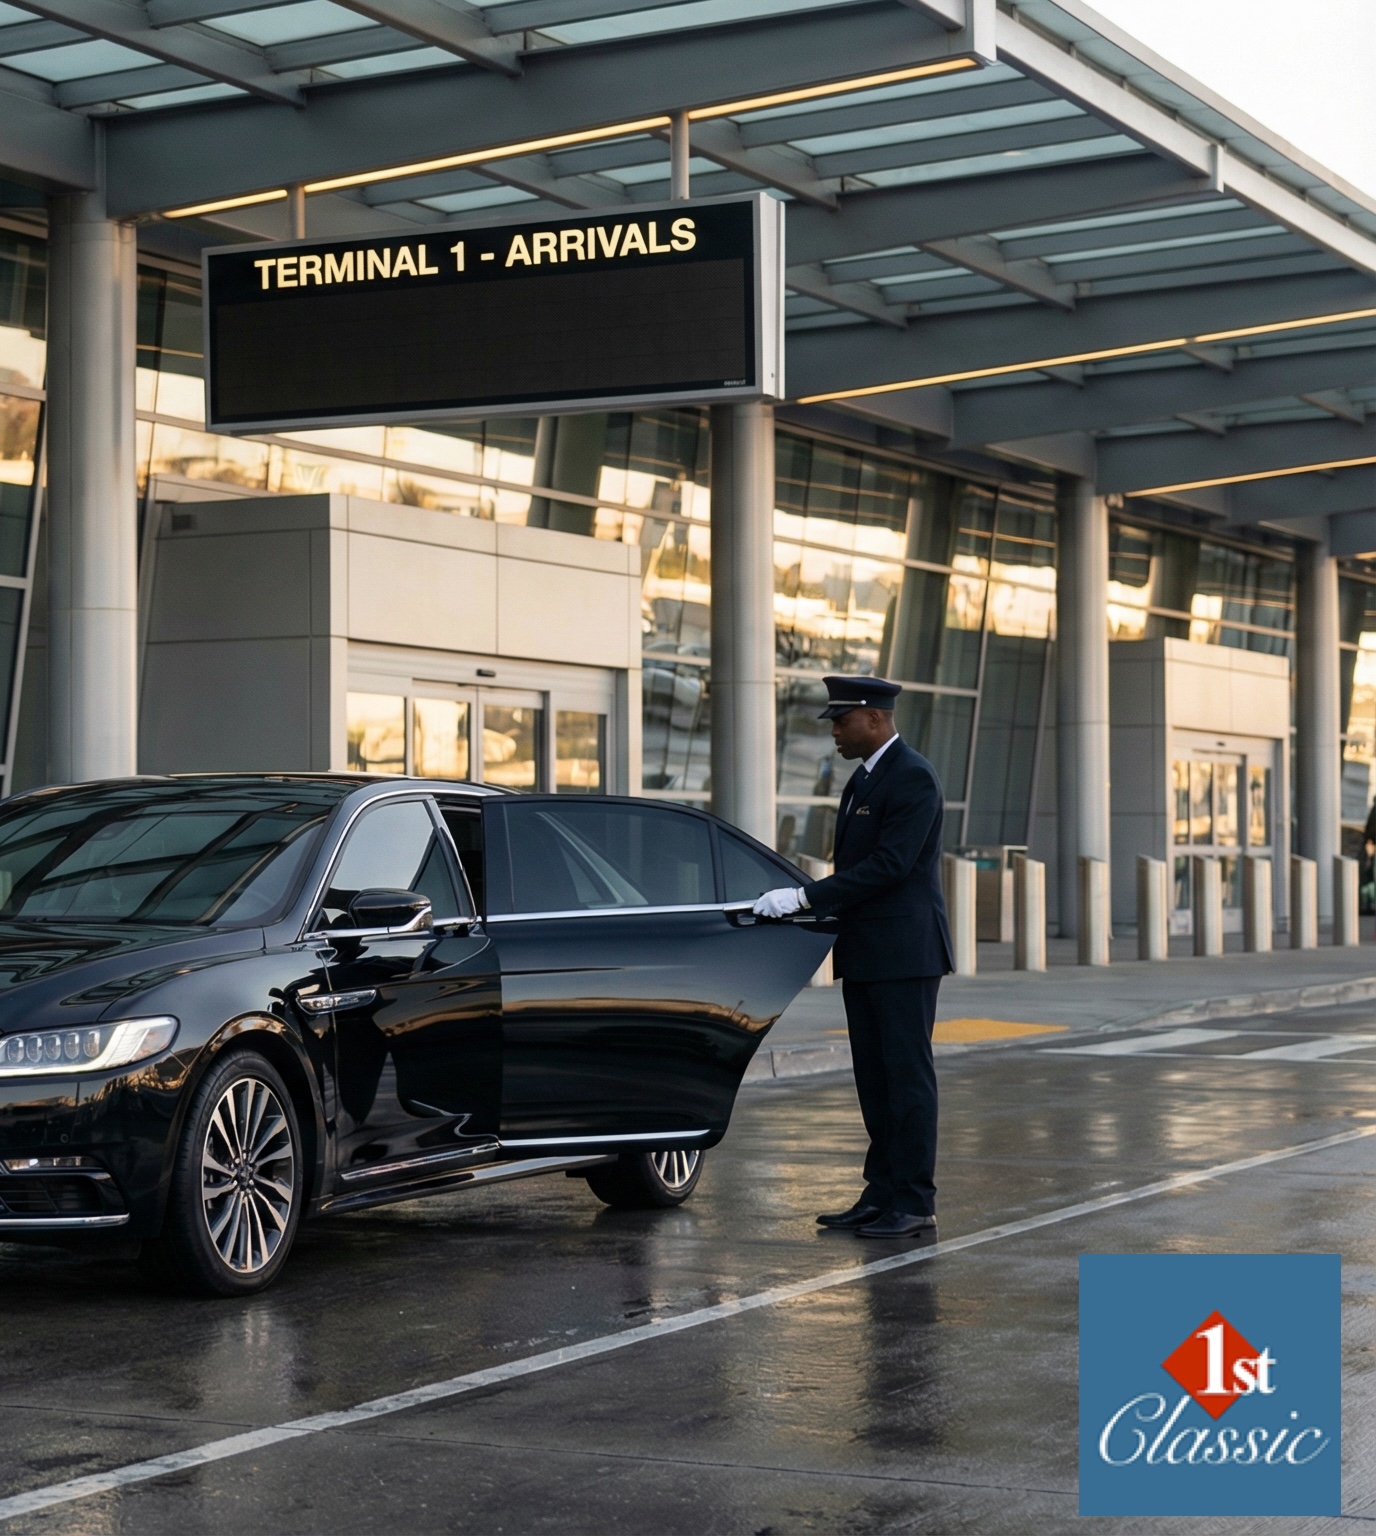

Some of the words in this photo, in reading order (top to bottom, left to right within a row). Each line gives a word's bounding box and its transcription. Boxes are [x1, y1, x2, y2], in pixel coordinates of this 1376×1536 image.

[254, 244, 439, 290] TERMINAL
[450, 241, 466, 272] 1
[480, 252, 495, 261] -
[505, 217, 697, 267] ARRIVALS
